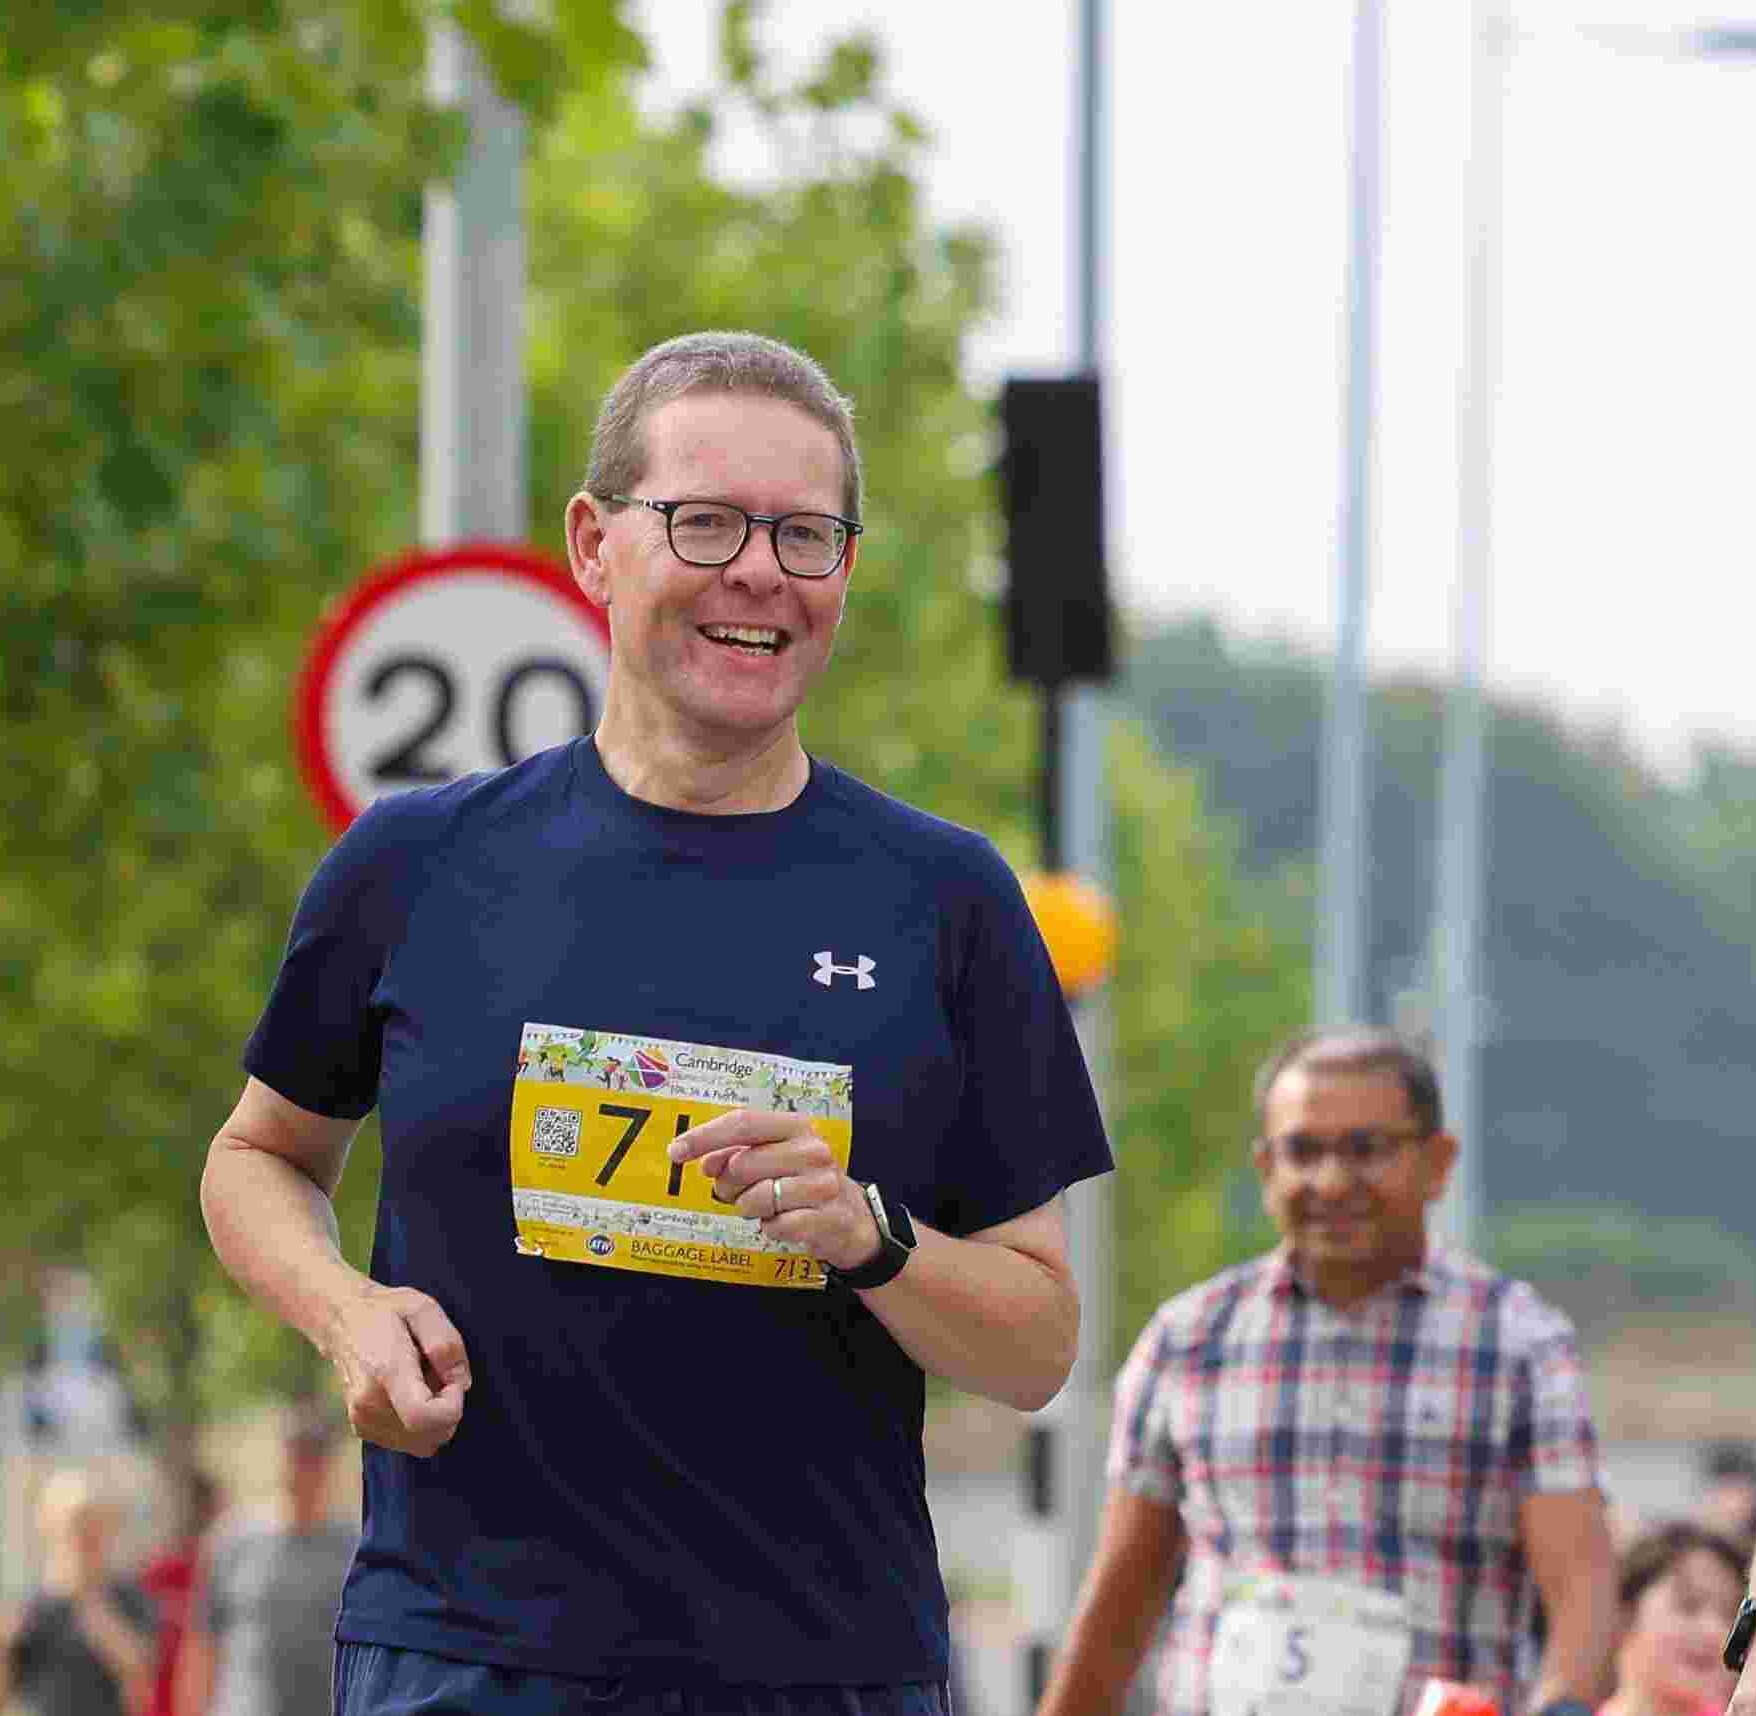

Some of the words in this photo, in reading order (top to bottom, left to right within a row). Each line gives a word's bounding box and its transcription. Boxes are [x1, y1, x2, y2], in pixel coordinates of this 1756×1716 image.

[365, 657, 595, 780] 20
[676, 1053, 753, 1079] Cambridge
[595, 1103, 736, 1205] 71
[631, 1240, 704, 1263] BAGGAGE
[710, 1251, 753, 1267] LABEL
[774, 1258, 812, 1281] 713
[1281, 1629, 1309, 1682] 5
